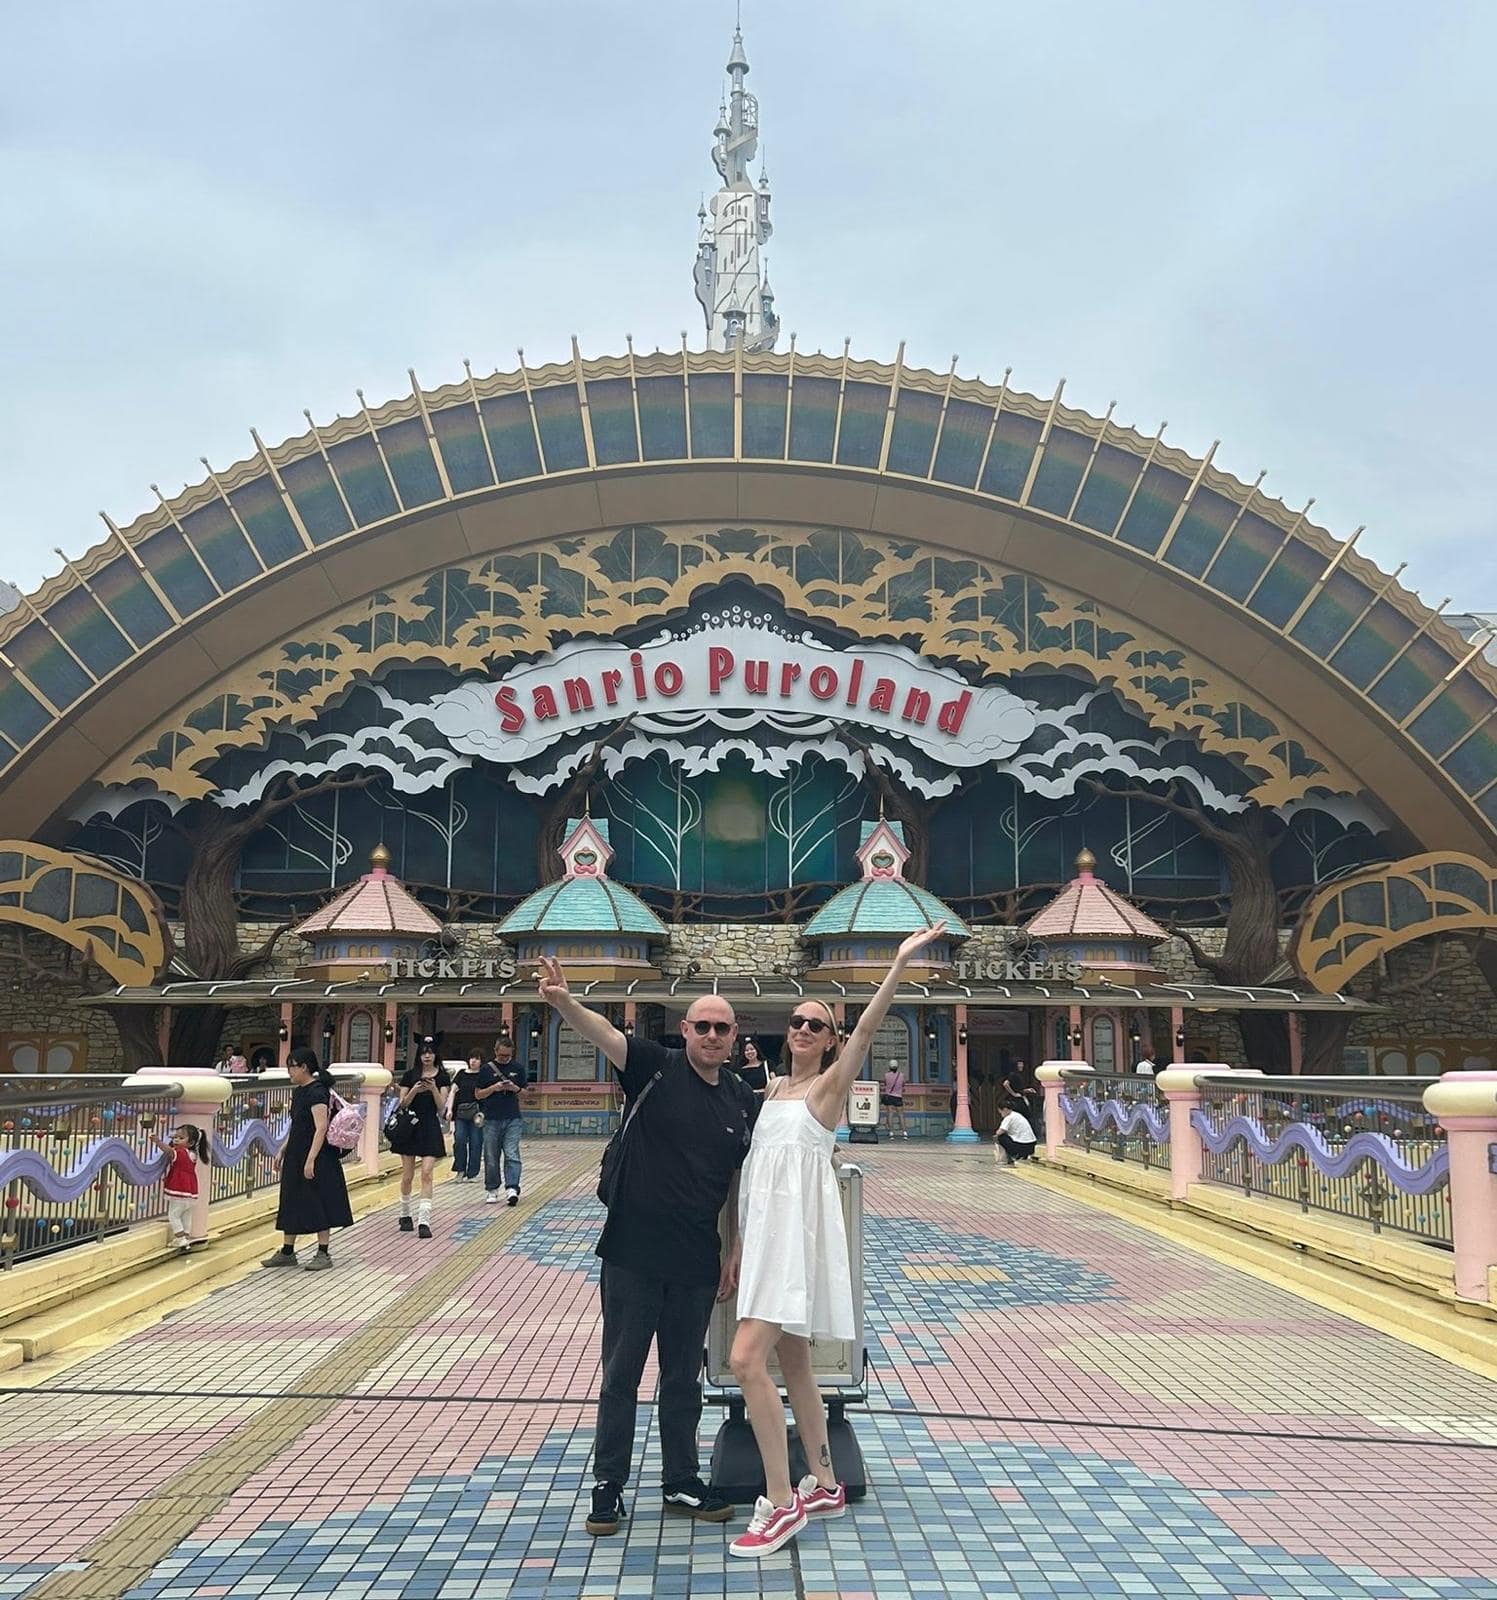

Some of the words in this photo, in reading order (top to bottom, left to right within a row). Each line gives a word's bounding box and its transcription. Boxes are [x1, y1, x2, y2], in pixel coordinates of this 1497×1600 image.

[494, 651, 684, 733] Sanrio
[708, 645, 973, 736] Puroland
[390, 958, 516, 978] TICKETS
[954, 960, 1083, 980] TICKETS
